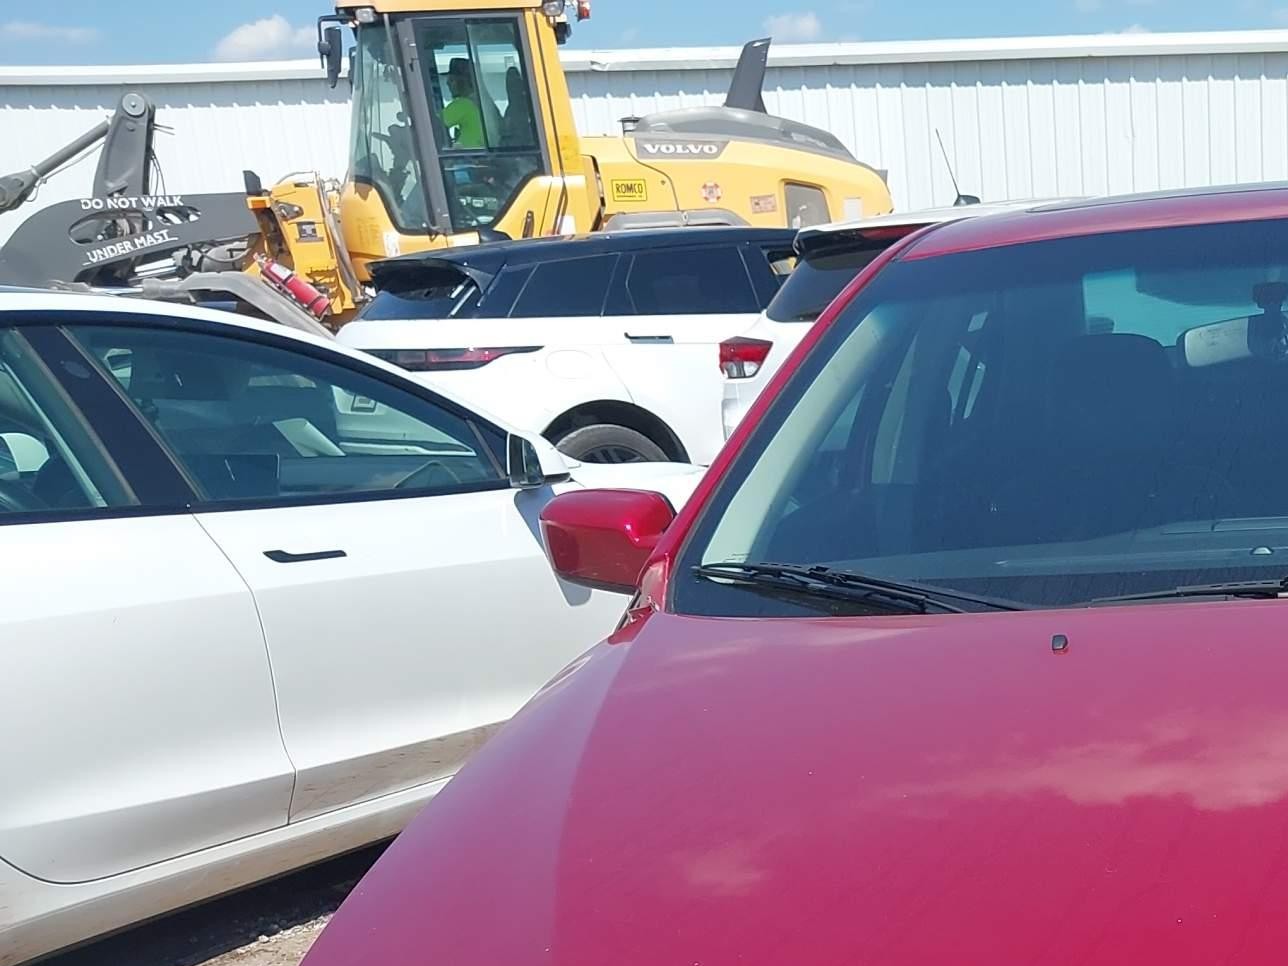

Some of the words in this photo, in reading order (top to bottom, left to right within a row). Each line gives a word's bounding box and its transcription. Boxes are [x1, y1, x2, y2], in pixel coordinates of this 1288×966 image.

[644, 143, 718, 154] VOLVO
[615, 183, 643, 194] ROMCO
[80, 198, 104, 210] DO
[106, 197, 138, 209] NOT
[141, 195, 184, 208] WALK
[87, 240, 134, 263] UNDER
[134, 229, 169, 249] MAST
